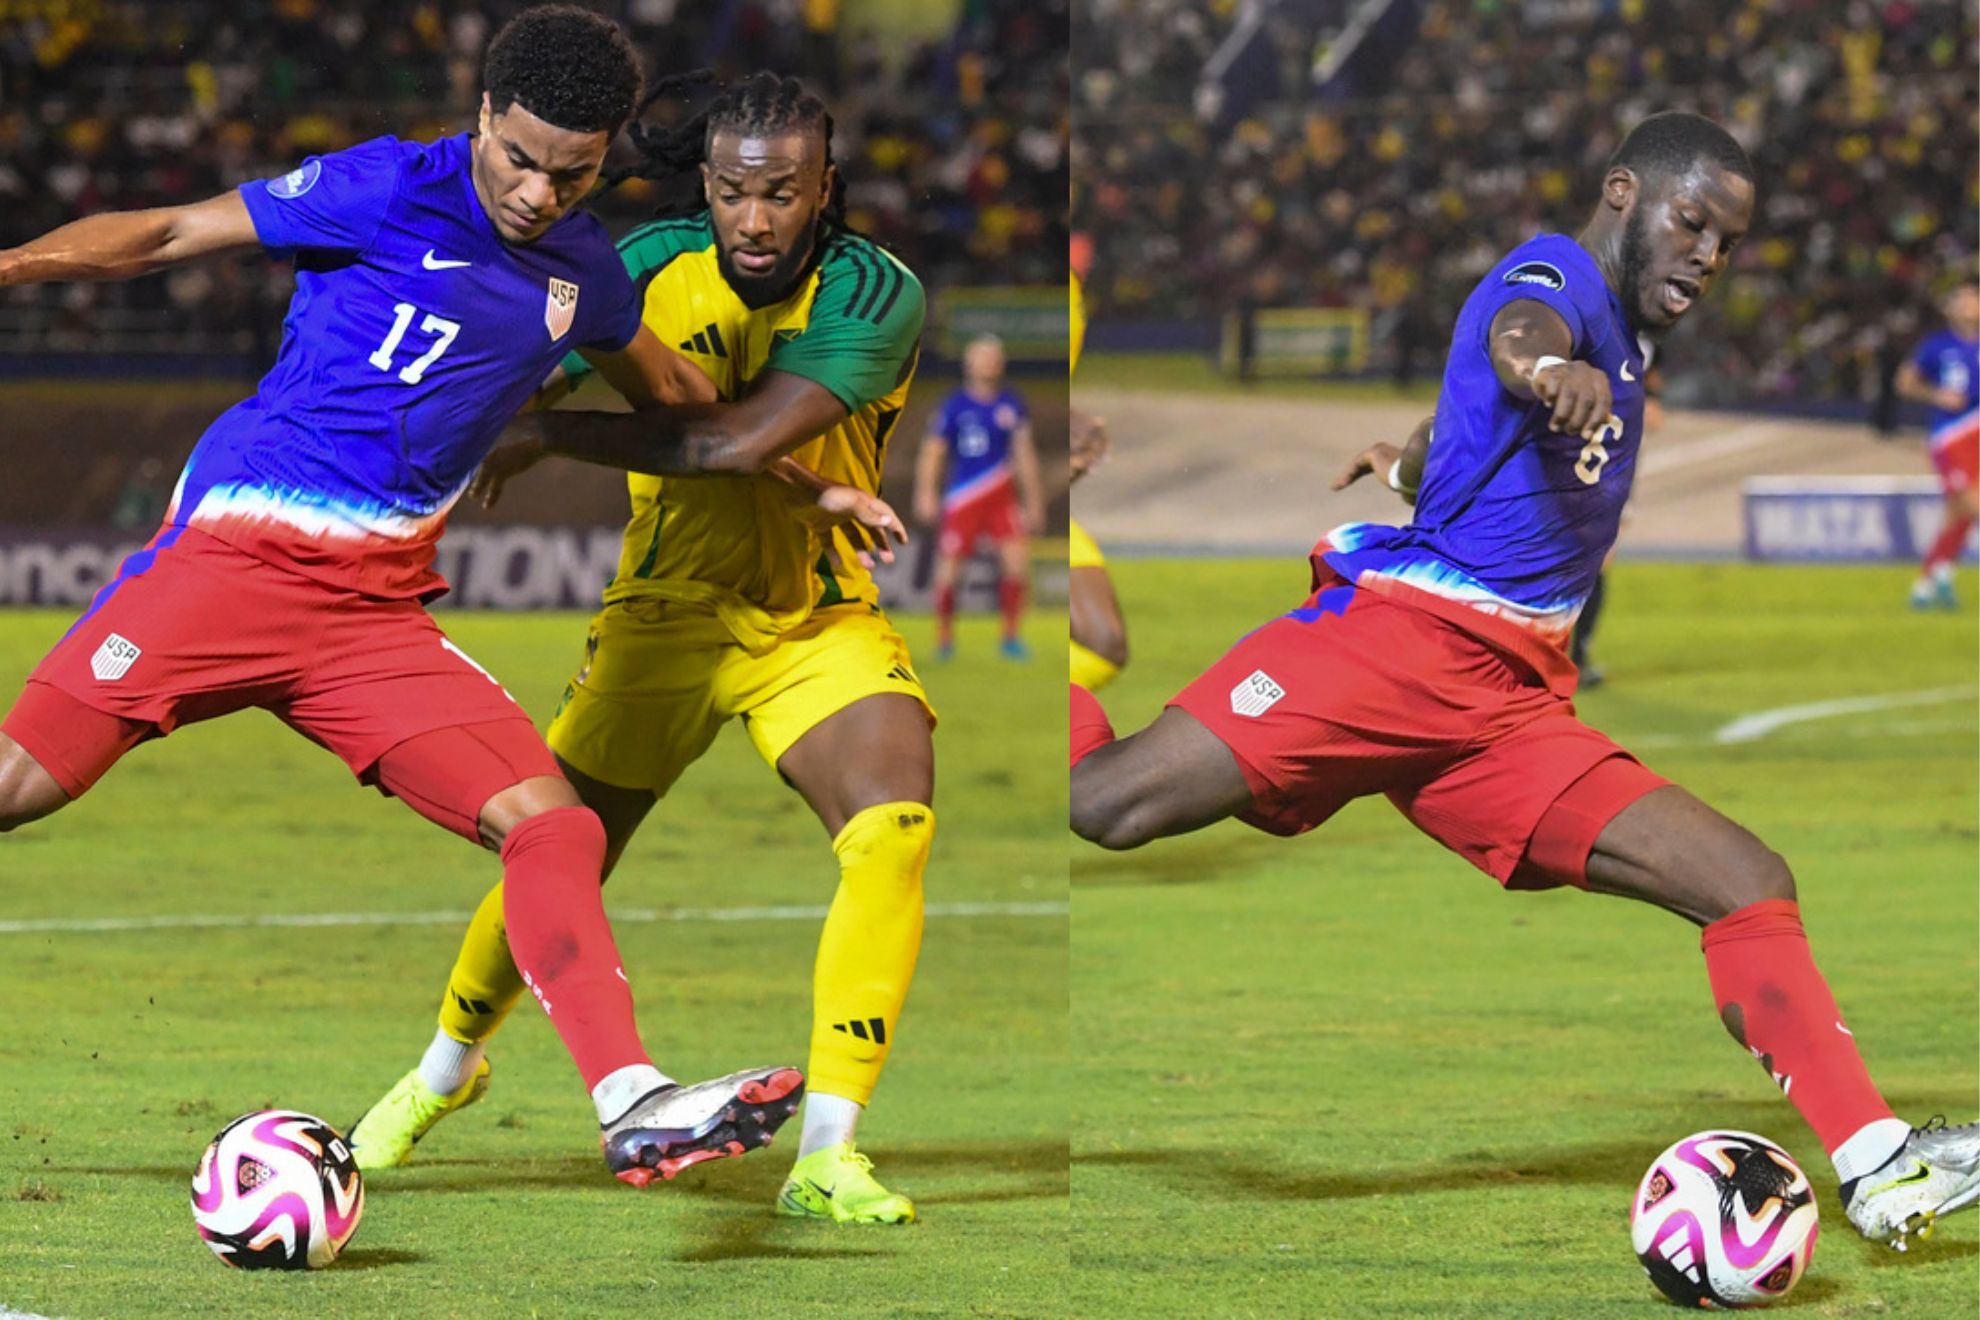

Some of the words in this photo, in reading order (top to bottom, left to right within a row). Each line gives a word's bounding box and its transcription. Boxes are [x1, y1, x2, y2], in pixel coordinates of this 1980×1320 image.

[550, 280, 576, 307] USA
[368, 302, 461, 385] 17
[1575, 413, 1624, 485] 6
[0, 541, 142, 607] nc
[105, 635, 138, 660] USA
[1250, 672, 1281, 700] USA
